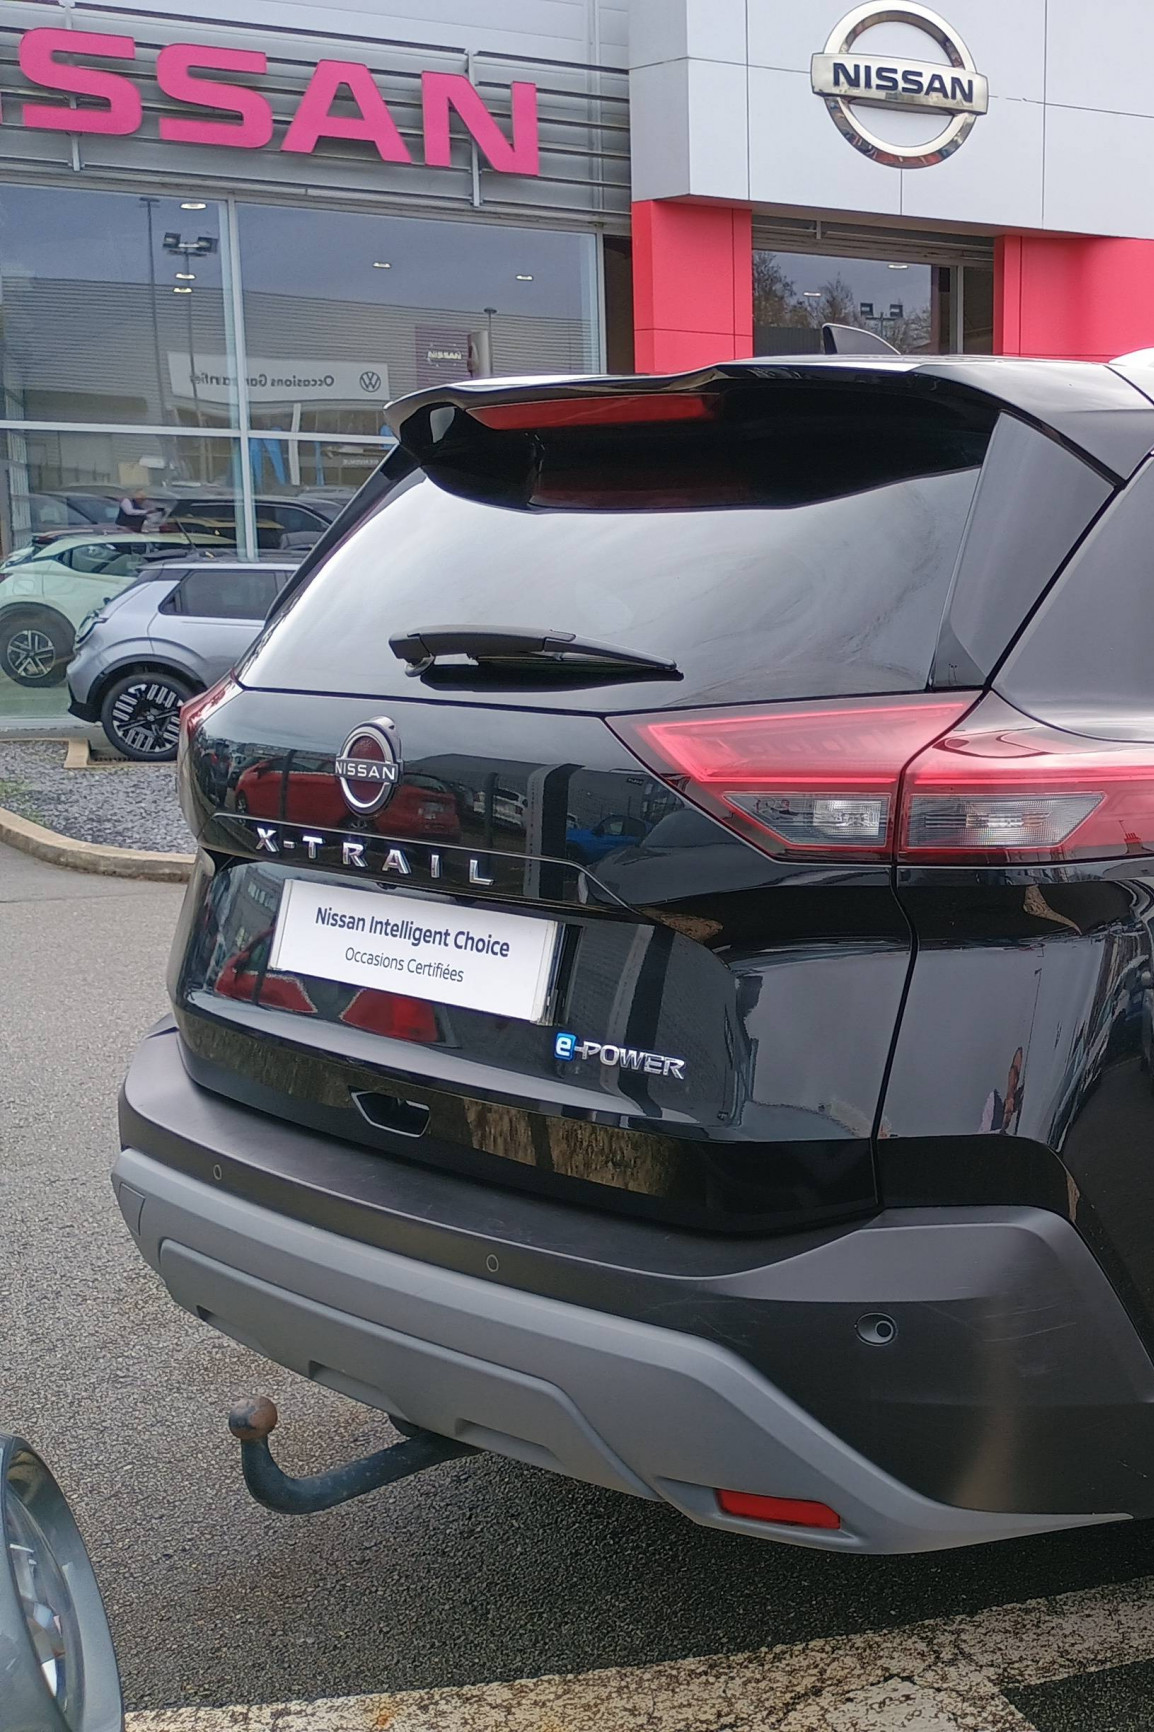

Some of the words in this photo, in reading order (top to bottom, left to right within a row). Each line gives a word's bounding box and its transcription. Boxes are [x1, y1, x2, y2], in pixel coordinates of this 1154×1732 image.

[0, 27, 540, 176] SSAN
[833, 62, 974, 102] NISSAN
[335, 761, 395, 780] NISSAN
[256, 827, 496, 886] X-TRAIL
[315, 907, 366, 932] Nissan
[369, 916, 450, 947] Intelligent
[453, 931, 511, 957] Choice
[345, 947, 404, 971] Occasions
[407, 958, 464, 983] Certifiées
